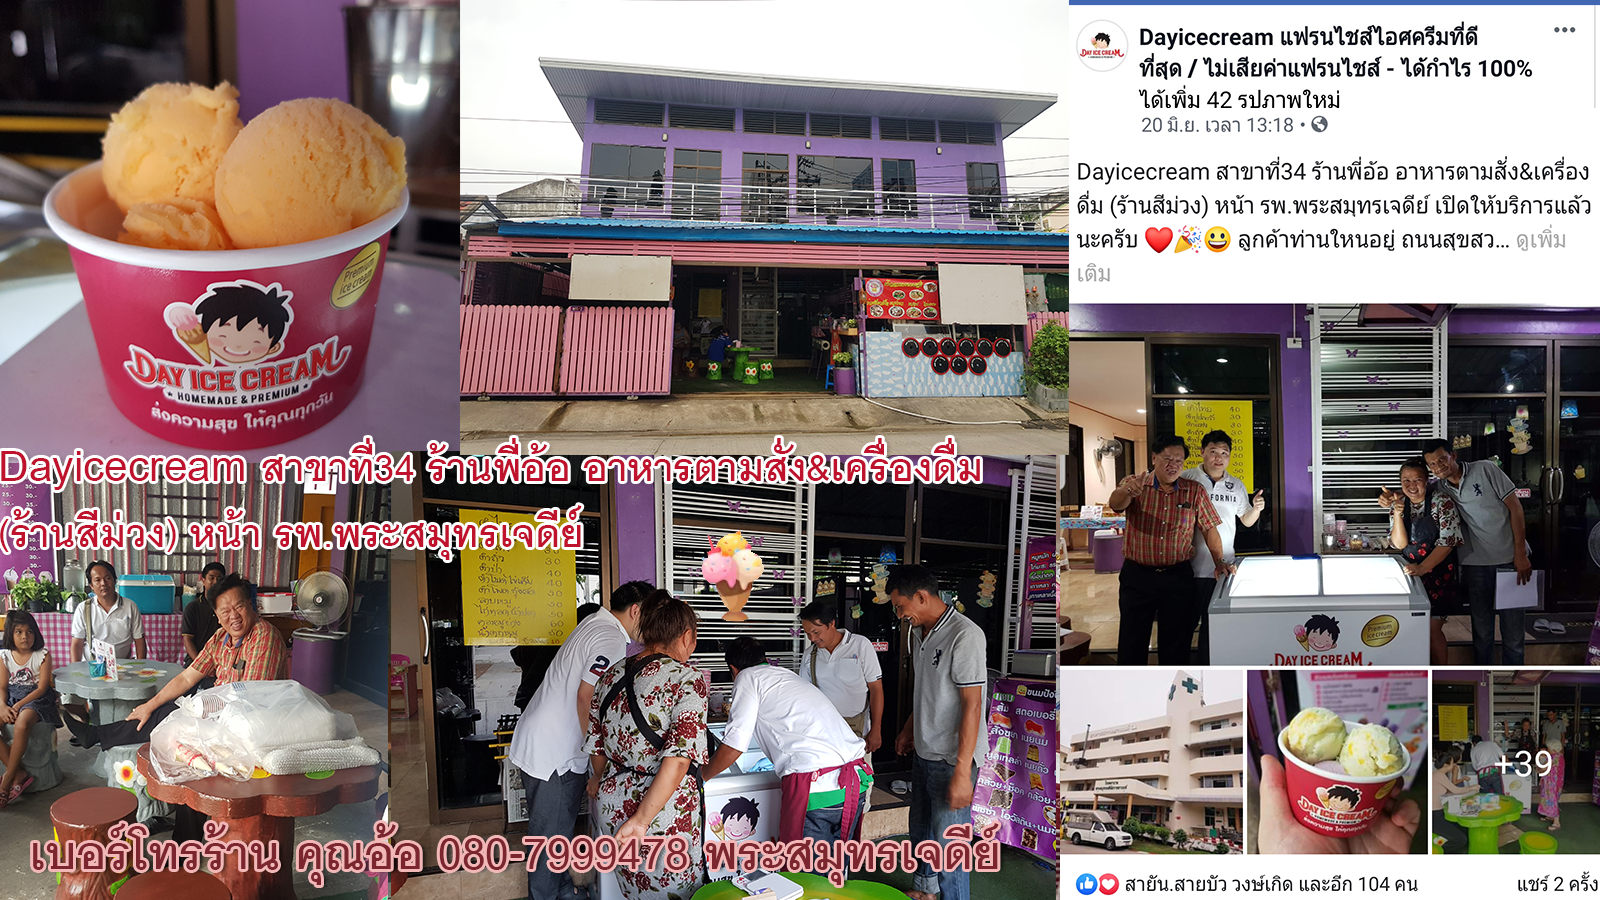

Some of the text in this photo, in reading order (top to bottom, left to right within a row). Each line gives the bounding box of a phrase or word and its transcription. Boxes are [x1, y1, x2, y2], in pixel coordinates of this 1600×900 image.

[1139, 21, 1478, 50] Dayicecream แฟรนไชส์ไอศครีมที่ดี
[1139, 54, 1182, 80] ที่สุด
[1187, 58, 1198, 78] /
[1203, 56, 1382, 78] ไม่เสียค่าแฟรนไชส์
[1399, 57, 1471, 78] ได้กำไร
[1478, 59, 1533, 78] 100%
[1139, 85, 1200, 108] ได้เพิ่ม
[1206, 91, 1233, 108] 42
[1141, 116, 1294, 133] 20 มิ.ย. เวลา 13:18
[1077, 156, 1589, 185] Dayicecream สาขาที่34 ร้านพี่อ้อ อาหารตามสั่ง&เครื่อง
[1077, 191, 1591, 219] ดื่ม (ร้านสีม่วง) หน้า รพ.พระสมุทรเจดีย์ เปิดให้บริการแล้ว
[1077, 225, 1566, 251] นะครับ ลูกค้าท่านใหนอยู่ ถนนสุขสว... ดูเพิ่ม
[344, 258, 375, 282] Premium
[1077, 263, 1111, 282] เติม
[339, 269, 373, 295] ice cream
[127, 341, 349, 392] DAY ICE CREAM
[177, 383, 300, 405] HOMEMADE & PREMIUM
[151, 391, 334, 433] ส่งความสุข ให้คุณทุกวัน
[1210, 494, 1237, 502] FORNIA
[1367, 623, 1392, 633] Premium
[589, 655, 610, 677] 2
[1274, 651, 1363, 666] DAY ICE CREAM
[1494, 750, 1552, 777] +39
[1299, 798, 1319, 812] DAY
[1320, 810, 1335, 819] ICE
[1125, 875, 1419, 892] สายัน.สายบัว วงษ์เกิด และอีก 104 คน
[1517, 872, 1599, 892] แชร์ 2 ครั้ง
